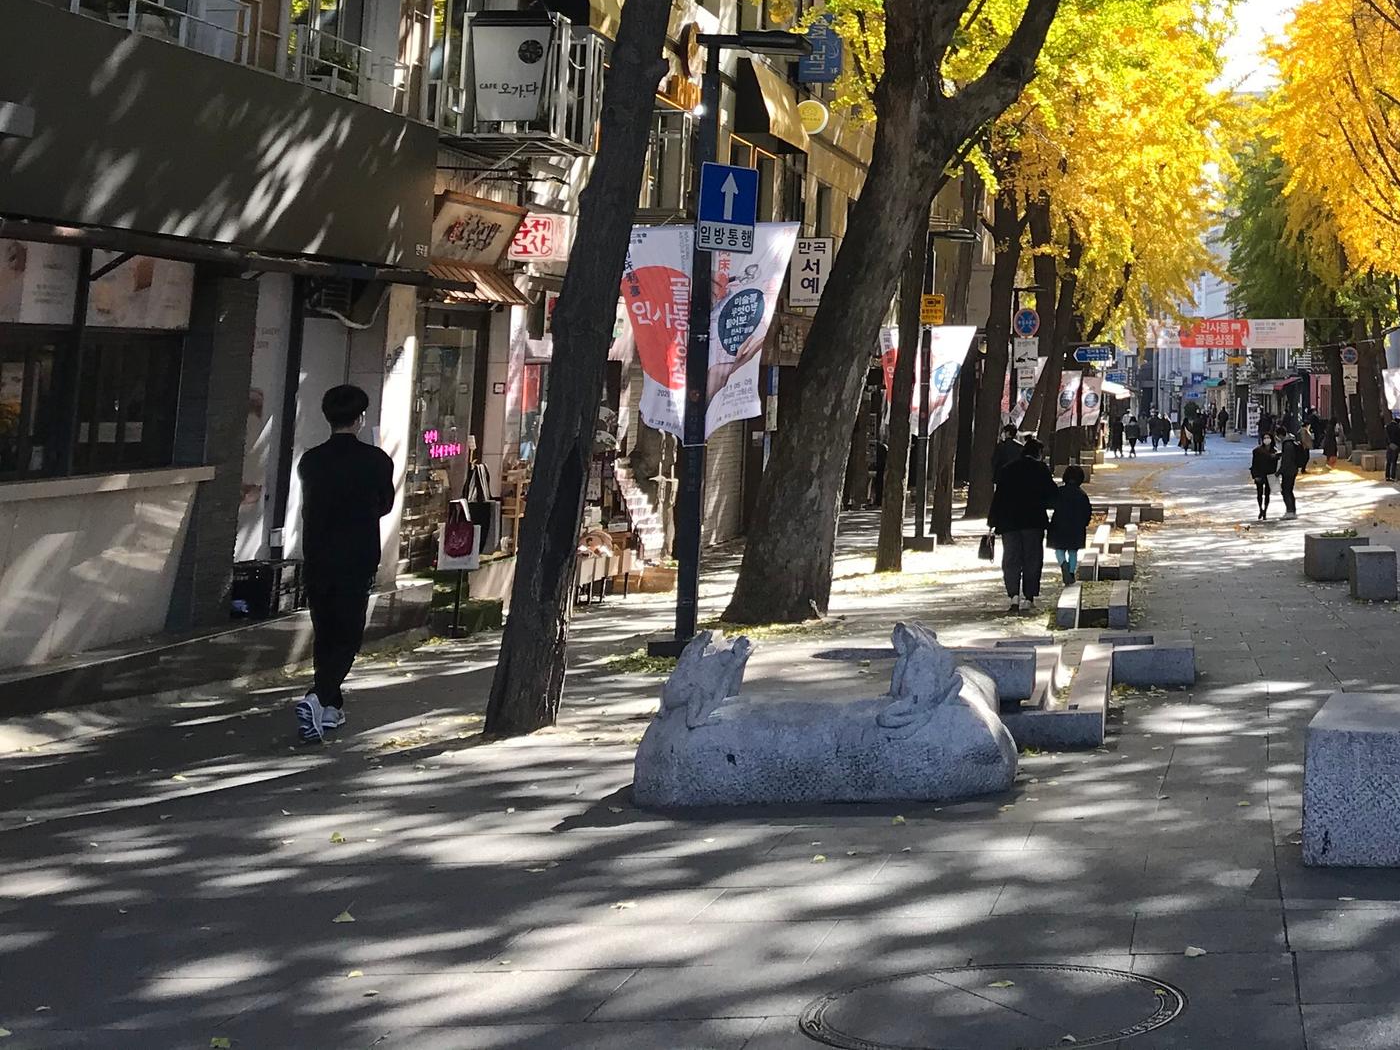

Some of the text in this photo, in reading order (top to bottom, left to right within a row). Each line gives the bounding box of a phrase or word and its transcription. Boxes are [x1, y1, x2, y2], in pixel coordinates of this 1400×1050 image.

[699, 225, 753, 248] 일방통행
[798, 240, 827, 256] 만곡
[799, 257, 821, 295] 서예
[1200, 322, 1231, 334] 인사동
[1194, 334, 1236, 346] 골동상점
